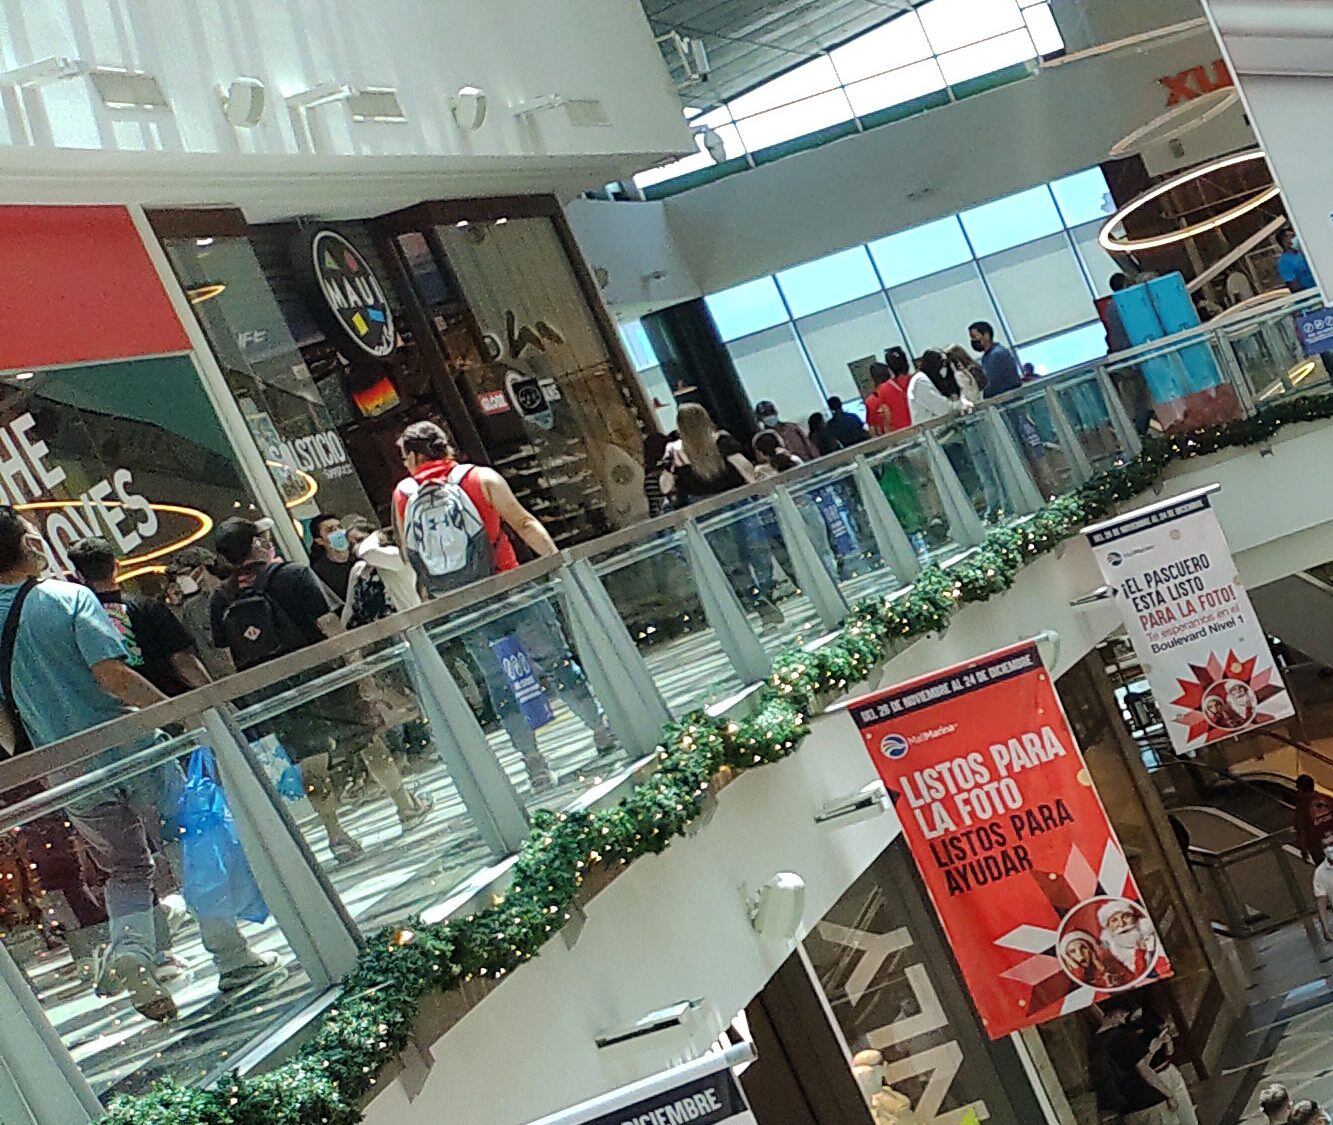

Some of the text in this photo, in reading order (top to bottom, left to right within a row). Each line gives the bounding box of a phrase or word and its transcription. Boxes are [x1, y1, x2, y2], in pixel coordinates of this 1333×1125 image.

[325, 275, 385, 310] MAUI
[0, 411, 67, 506] HE
[1144, 553, 1210, 588] PASCUERO
[1167, 576, 1205, 600] LISTO
[1139, 585, 1237, 632] PARA LA FOTO!
[1151, 615, 1245, 654] Boulevard Nivel 1
[900, 725, 1066, 809] LISTOS PARA
[913, 777, 1023, 840] LA FOTO
[929, 798, 1075, 869] LISTOS PARA
[942, 844, 1035, 897] AYUDAR
